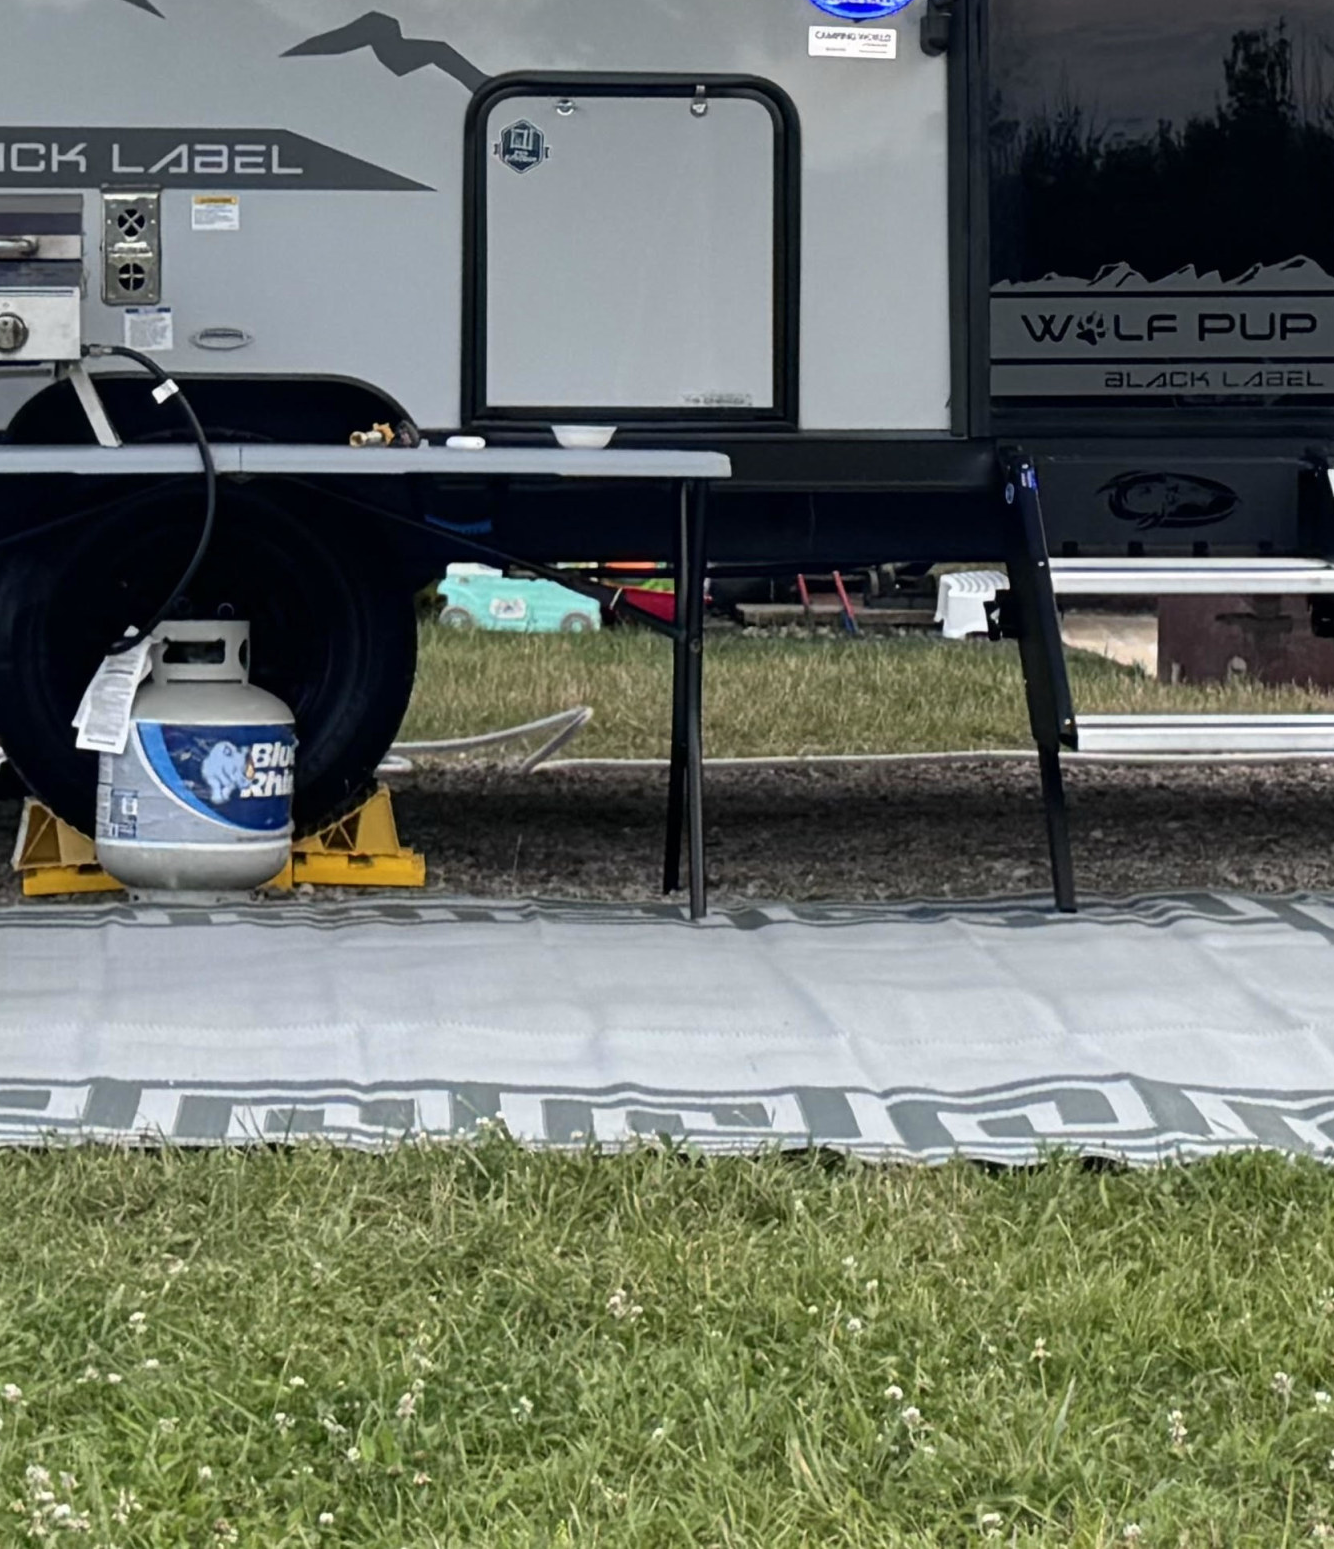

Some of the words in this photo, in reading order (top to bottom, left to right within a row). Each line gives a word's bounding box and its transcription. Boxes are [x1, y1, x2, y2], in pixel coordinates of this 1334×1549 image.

[815, 30, 857, 41] CAMPING
[858, 33, 892, 42] WORLD
[111, 143, 304, 175] LABEL
[1021, 311, 1178, 346] WLF
[1198, 312, 1318, 343] PUP
[1103, 369, 1211, 390] BLACK
[1222, 370, 1324, 390] LABEL
